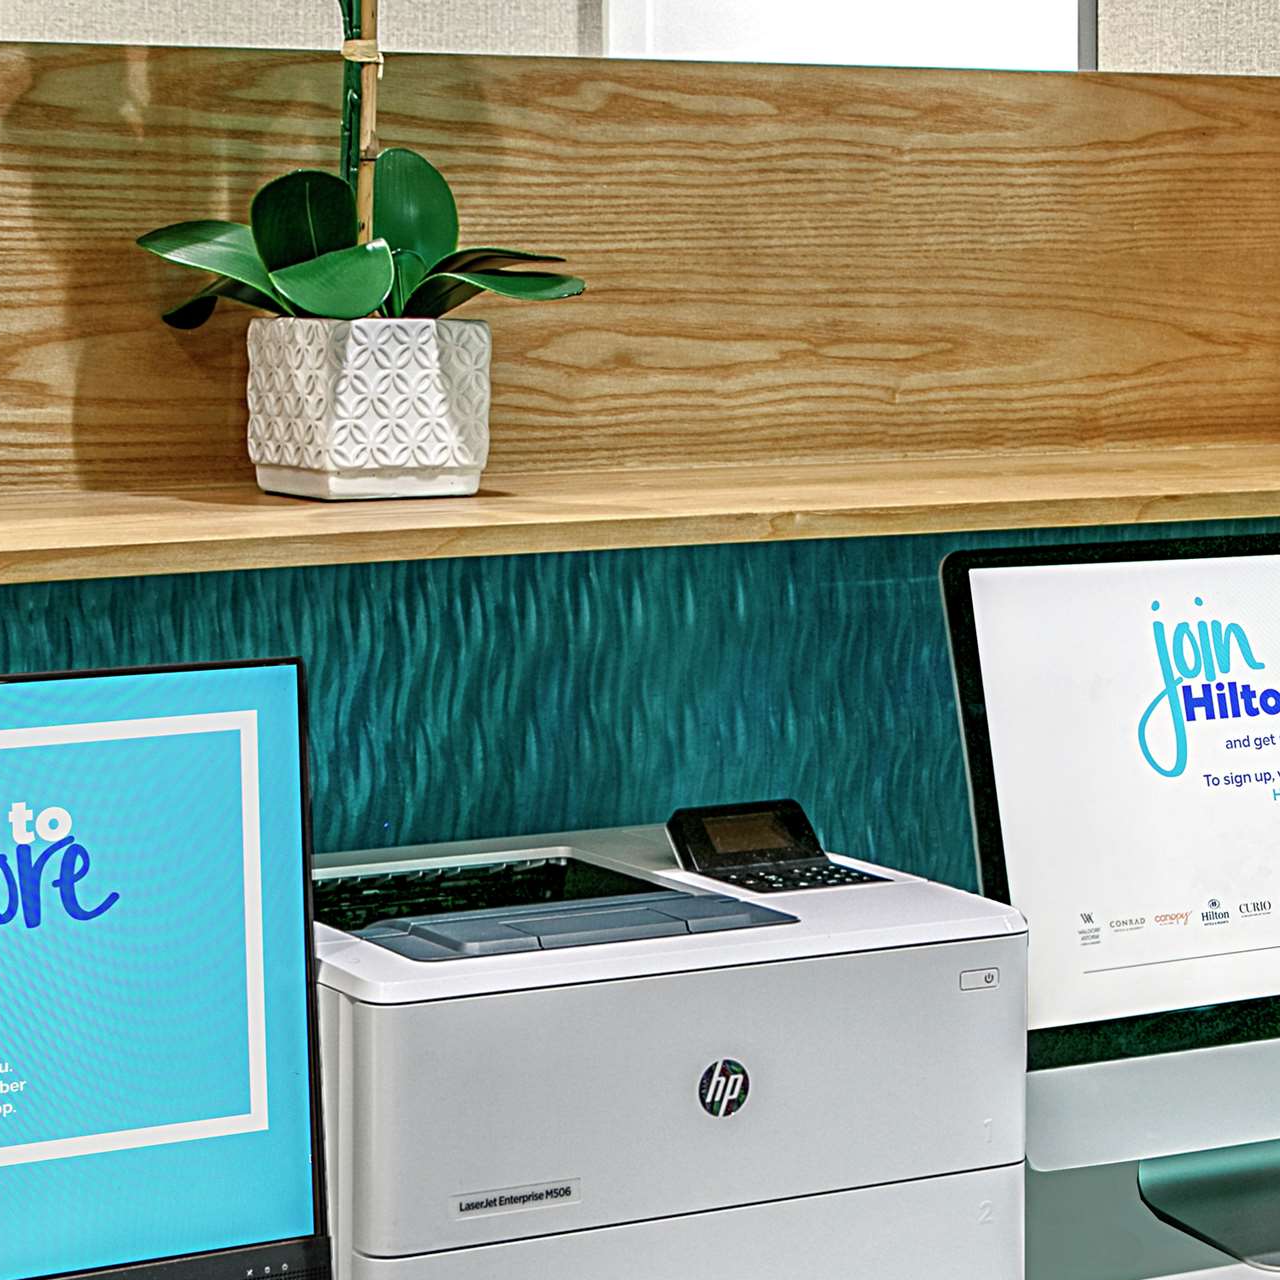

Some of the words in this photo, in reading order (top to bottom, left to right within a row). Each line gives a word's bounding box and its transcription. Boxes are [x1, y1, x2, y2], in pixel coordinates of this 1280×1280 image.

[1138, 596, 1266, 778] join
[1224, 735, 1251, 750] and
[1253, 732, 1277, 750] get
[1203, 773, 1221, 787] To
[1223, 770, 1252, 788] sign
[1255, 768, 1276, 785] up,
[8, 799, 74, 845] to
[1201, 910, 1230, 922] Hilton
[1238, 899, 1272, 914] CURIO
[1109, 917, 1146, 928] CONRAD
[704, 1059, 745, 1117] hp
[983, 1117, 994, 1145] 1
[459, 1197, 498, 1213] LaserJet
[498, 1189, 545, 1208] Enterprise
[545, 1185, 572, 1200] M506
[976, 1200, 994, 1225] 2
